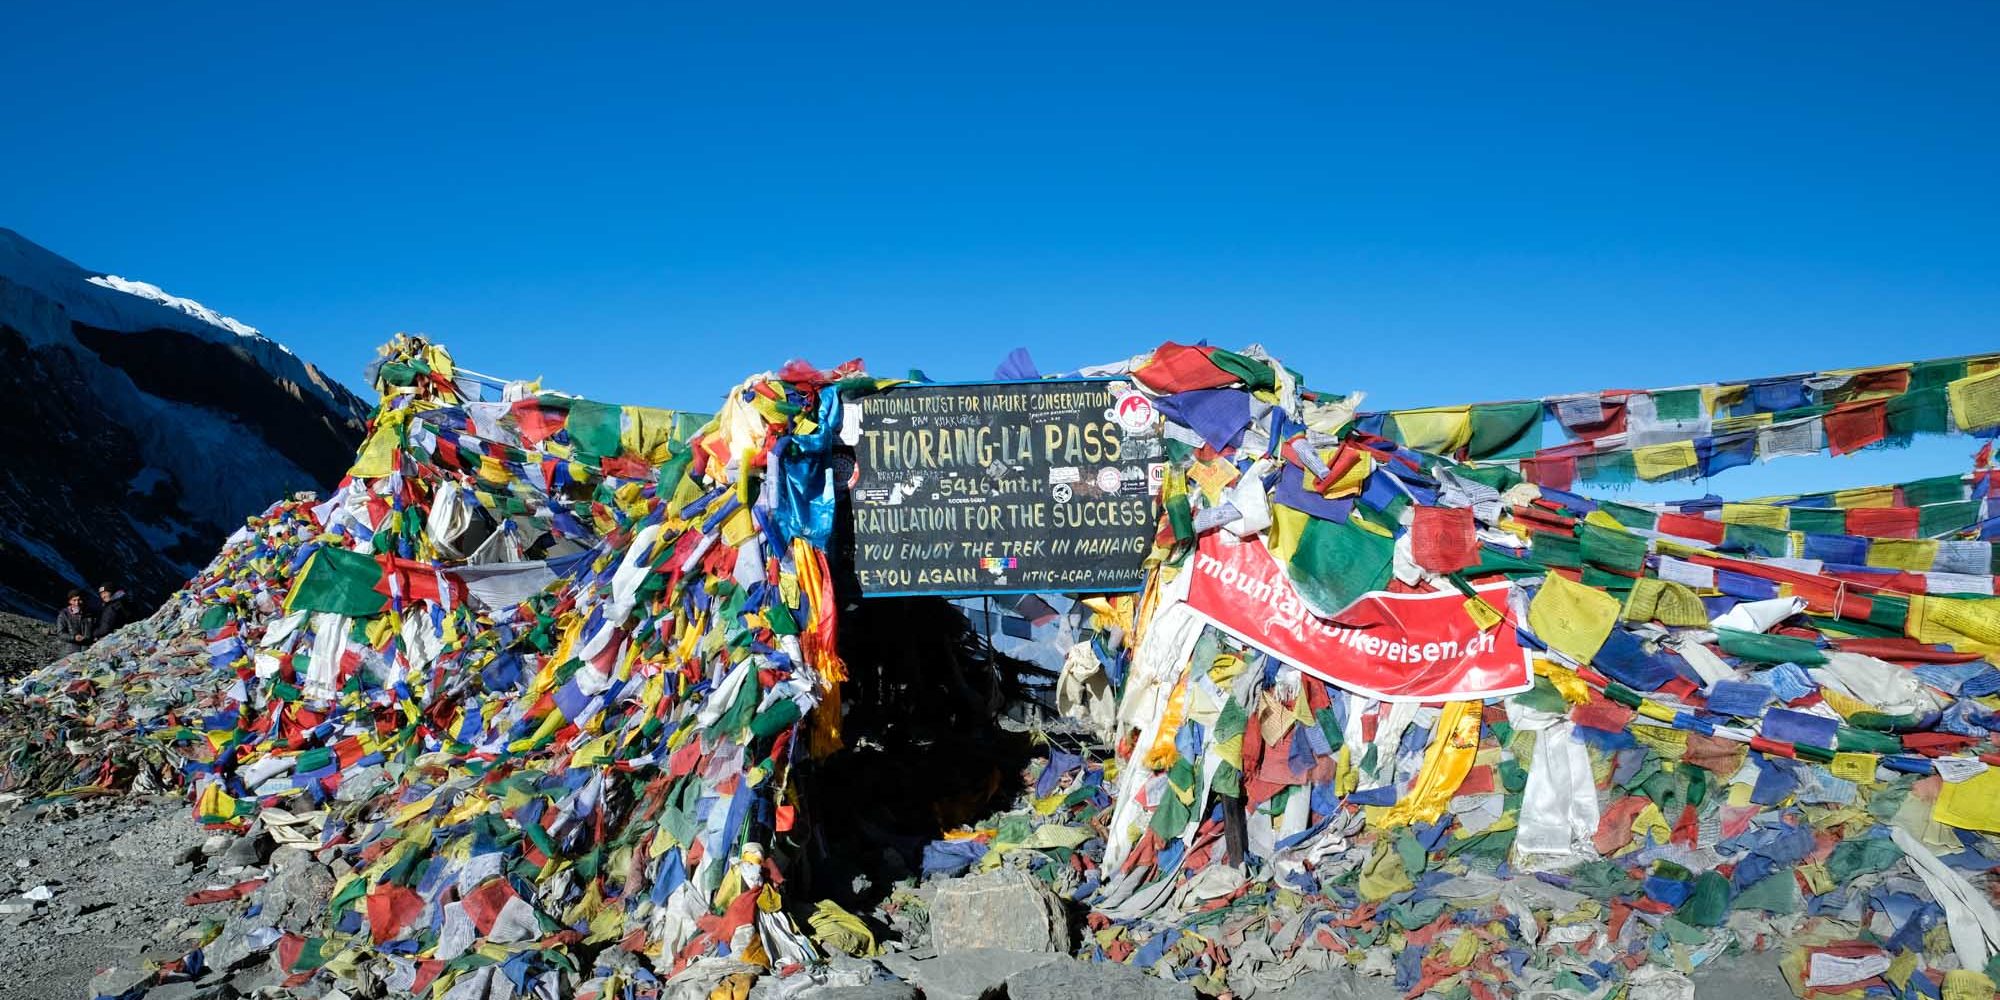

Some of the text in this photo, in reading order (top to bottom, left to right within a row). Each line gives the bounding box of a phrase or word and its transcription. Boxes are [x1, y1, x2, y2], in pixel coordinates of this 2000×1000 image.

[864, 392, 1111, 415] NATIONAL TRUST FOR NATURE CONSERVATION
[1045, 422, 1121, 465] PASS
[940, 475, 990, 497] 5416
[999, 476, 1044, 494] mtr.
[964, 505, 1005, 531] FOR
[1007, 502, 1045, 528] THE
[1052, 500, 1146, 528] SUCCESS
[864, 543, 895, 561] YOU
[901, 542, 954, 560] ENJOY
[961, 541, 994, 559] THE
[1001, 540, 1046, 557] TREK
[1051, 538, 1070, 555] IN
[1074, 536, 1145, 557] MANANG
[875, 569, 911, 586] YOU
[918, 568, 978, 585] AGAIN
[1097, 568, 1145, 580] MANANG
